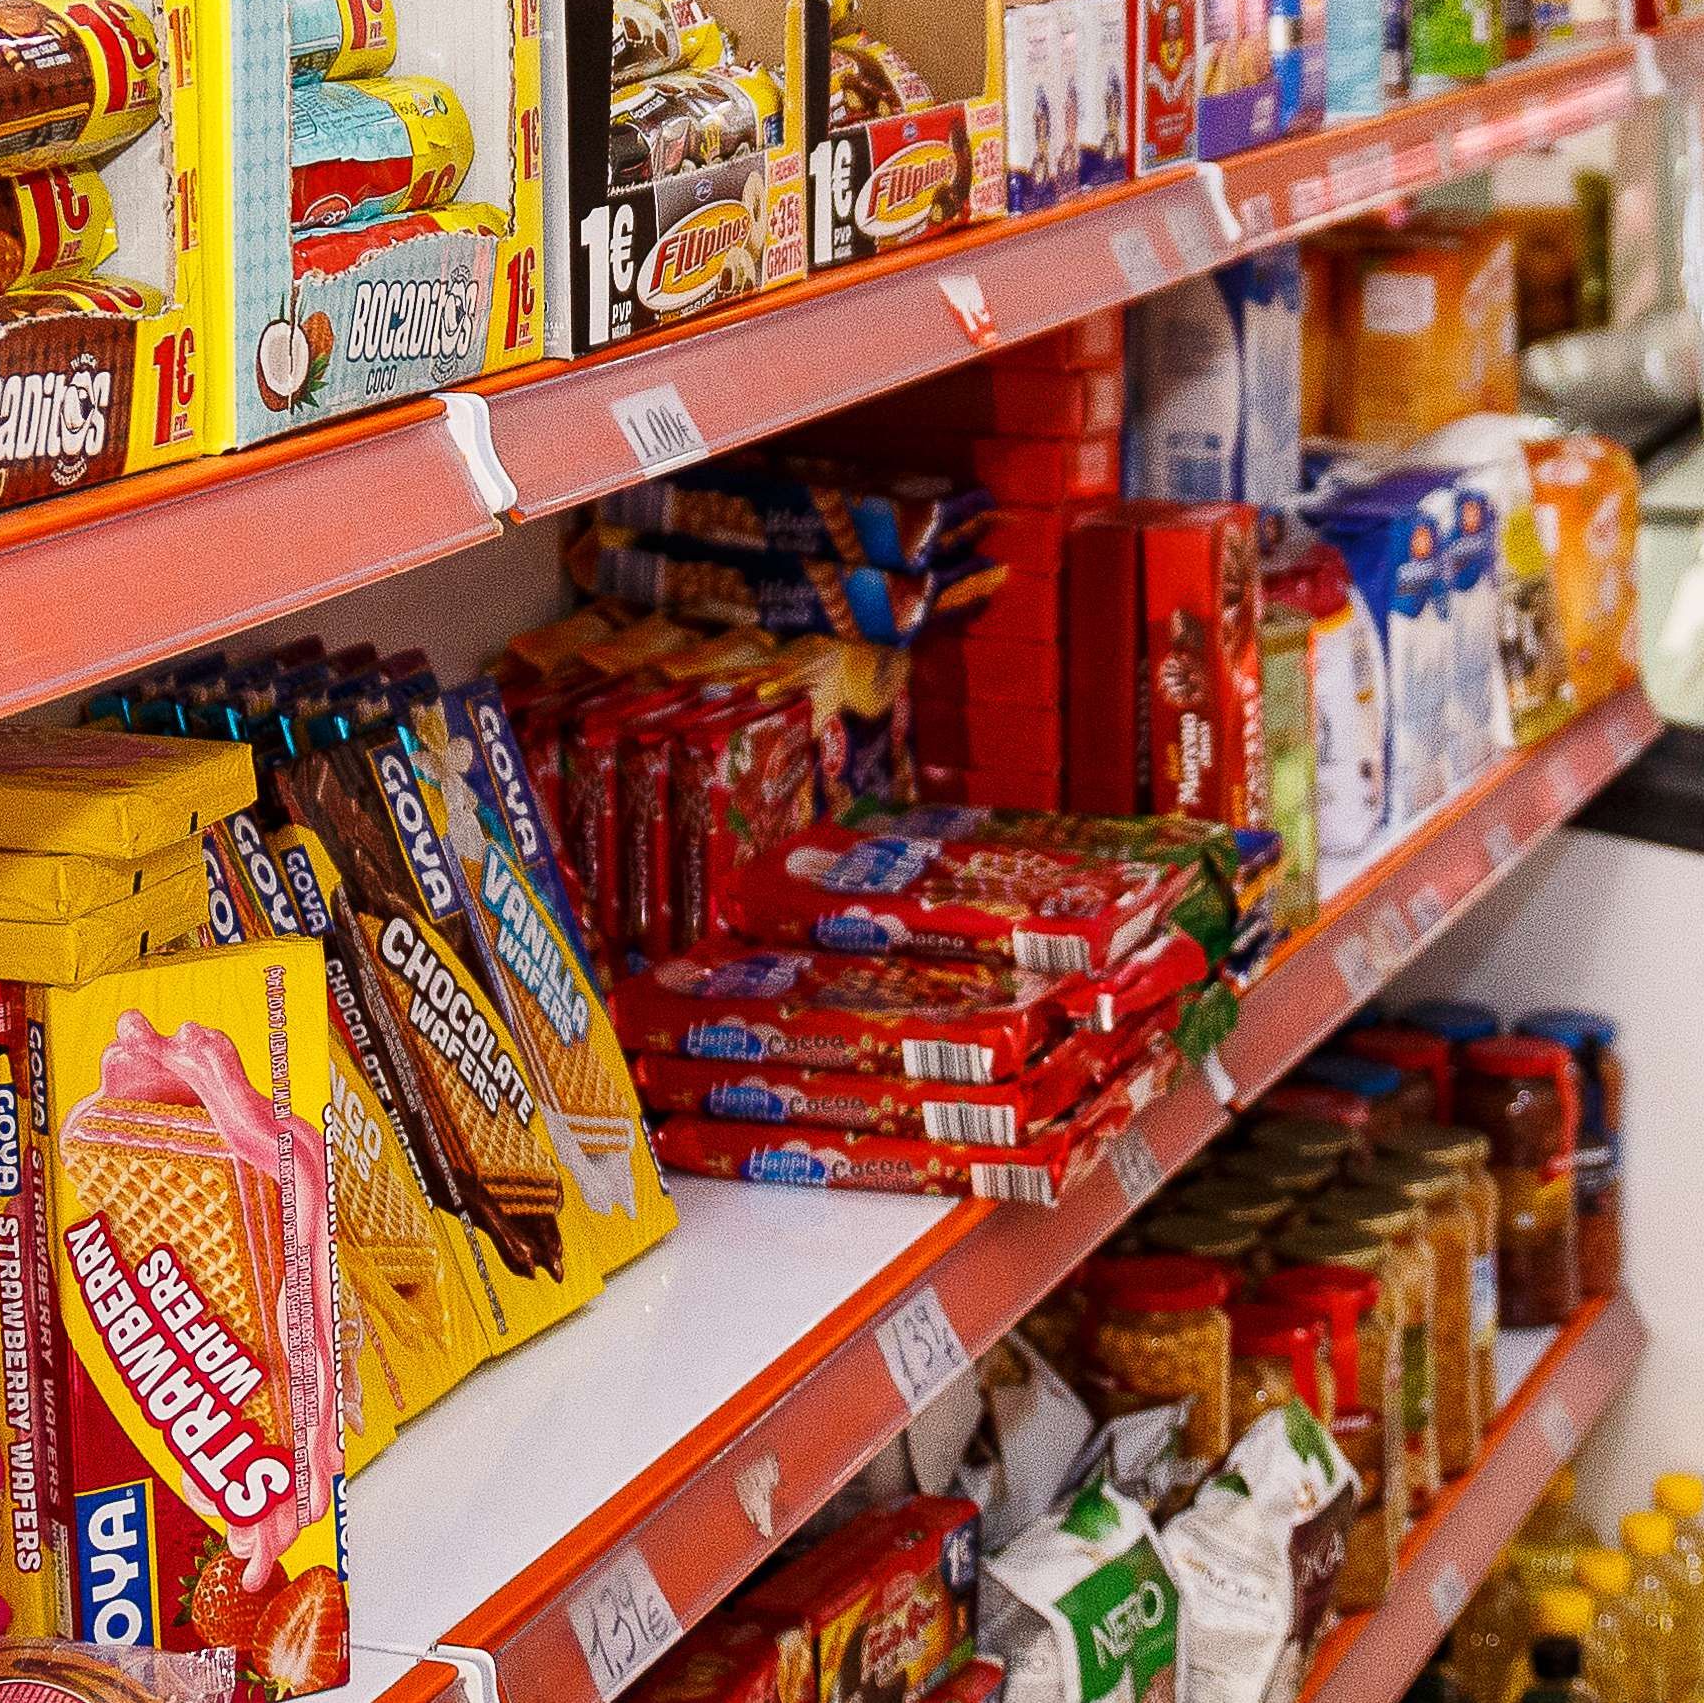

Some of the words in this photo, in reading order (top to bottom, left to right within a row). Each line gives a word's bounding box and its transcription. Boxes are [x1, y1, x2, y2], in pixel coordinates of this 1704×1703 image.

[67, 0, 155, 114] 1€
[809, 138, 853, 265] 1€
[504, 247, 538, 352] 1€
[581, 202, 636, 346] 1€
[610, 302, 633, 326] PVP
[152, 326, 196, 447] 1€
[364, 361, 399, 396] COCO
[379, 753, 454, 913] GOYA
[477, 703, 540, 859] GOYA
[285, 849, 327, 933] GOYA
[486, 859, 591, 1036] VANILLA
[269, 1033, 288, 1056] NETO
[326, 957, 390, 1105] CHOCOLATE
[380, 915, 535, 1126] CHOCOLATE
[499, 928, 574, 1045] WAFERS
[27, 1022, 49, 1131] GOYA
[270, 1056, 289, 1079] PESO
[272, 1100, 291, 1122] NET
[409, 992, 499, 1115] WAFERS
[30, 1148, 55, 1366] STRAWBERRY
[67, 1216, 293, 1520] STRAWBERRY
[136, 1248, 263, 1406] WAFERS
[42, 1370, 63, 1507] WAFERS
[7, 1442, 41, 1573] WAFERS
[86, 1494, 143, 1646] OYA
